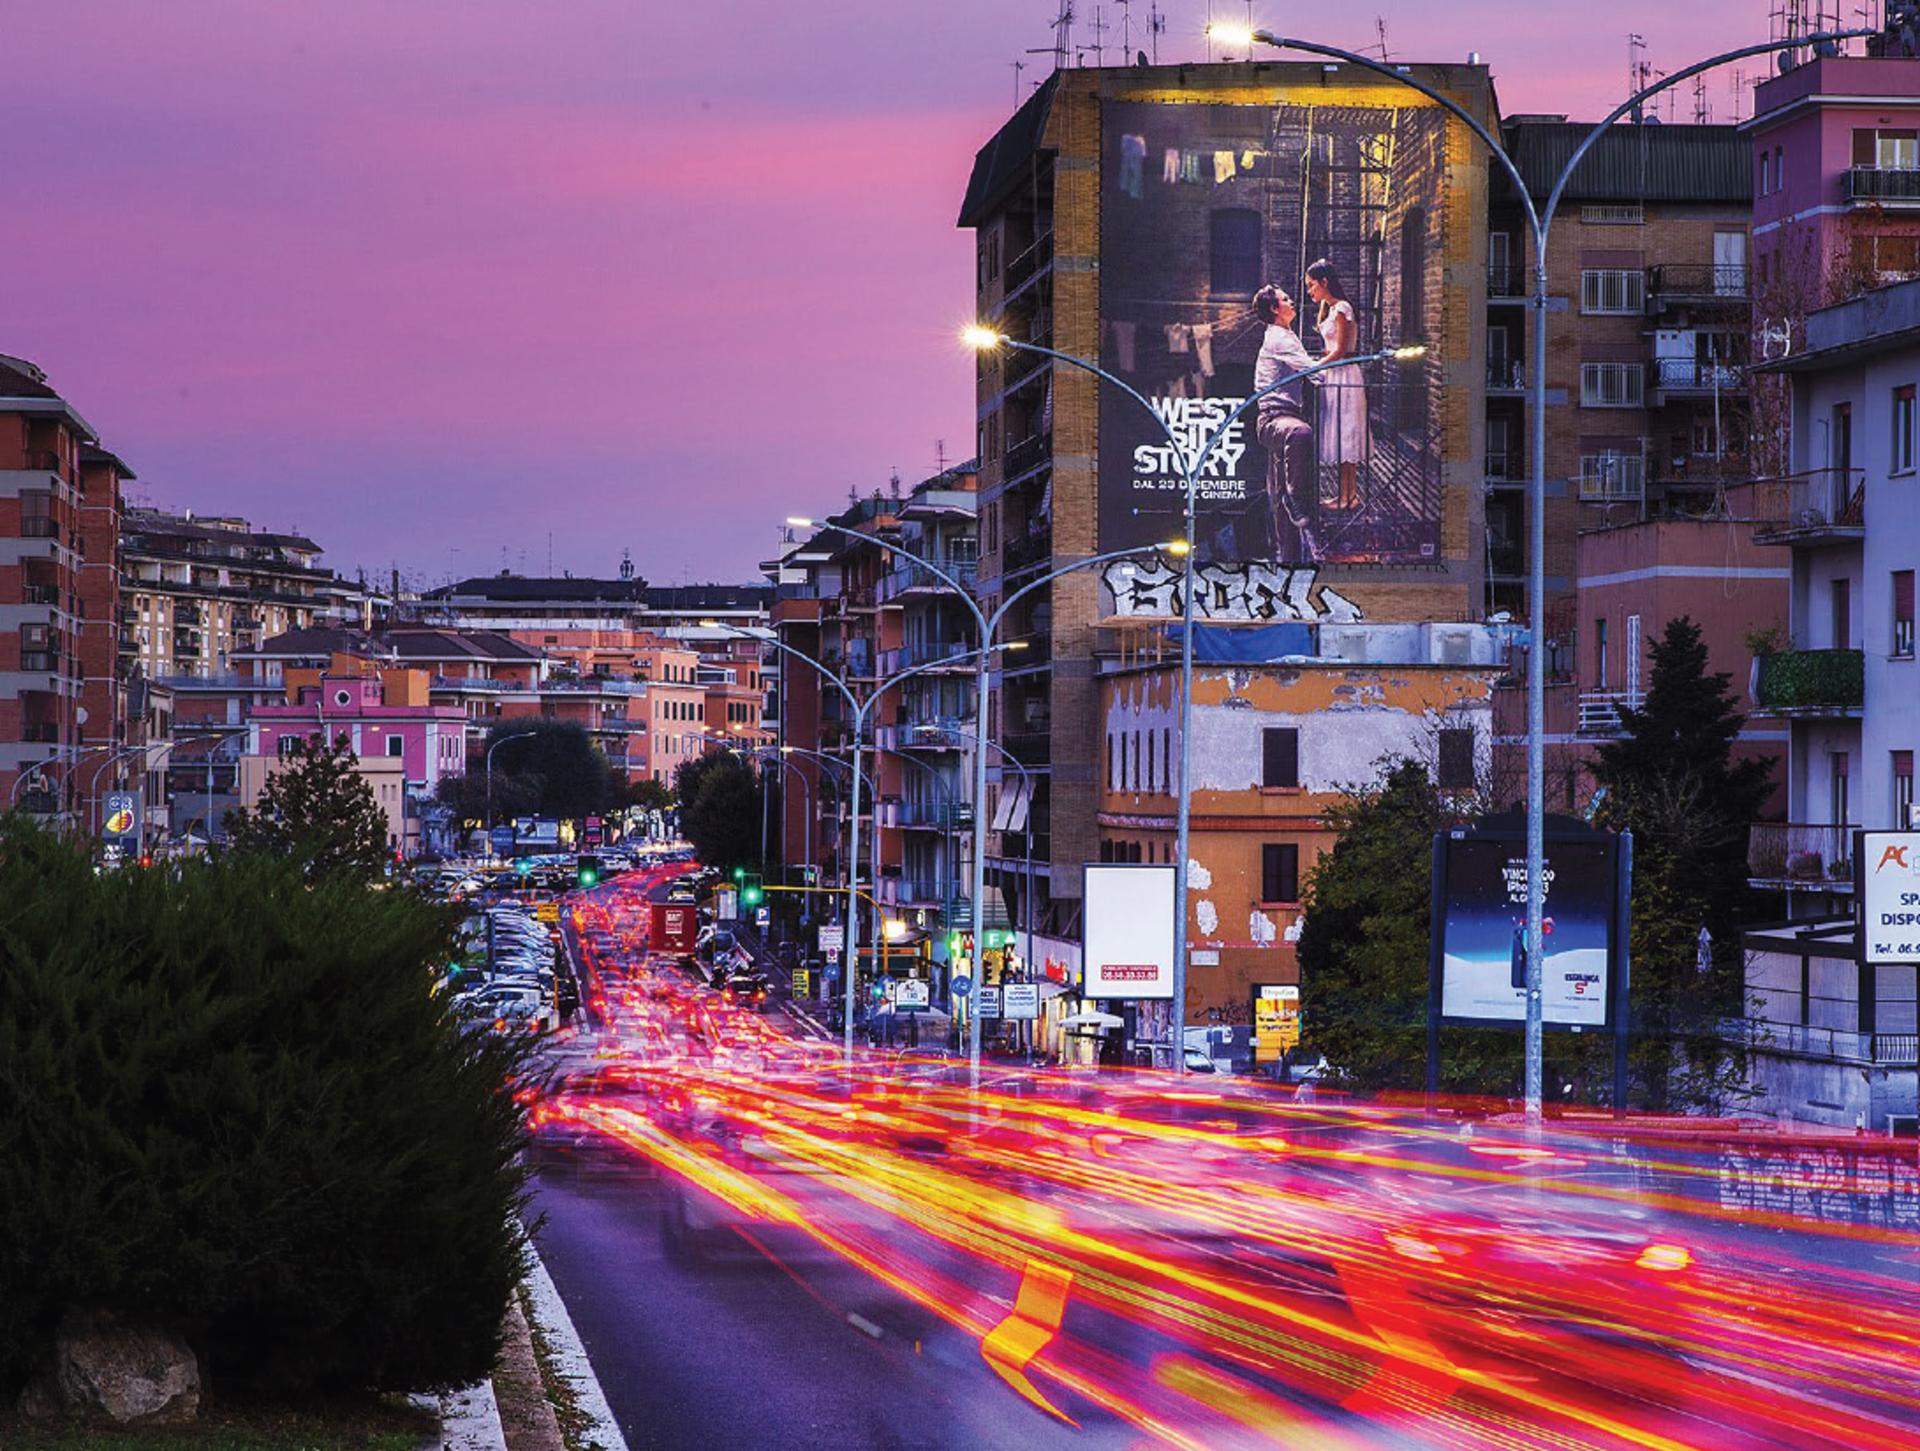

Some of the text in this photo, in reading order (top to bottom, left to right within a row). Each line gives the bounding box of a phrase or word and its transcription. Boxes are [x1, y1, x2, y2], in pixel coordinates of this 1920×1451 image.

[1150, 396, 1245, 424] WEST
[1166, 421, 1245, 450] SIDE
[1133, 443, 1246, 477] STORY
[1133, 481, 1155, 489] DAL
[1179, 481, 1246, 490] DCEMBRE
[1201, 491, 1246, 500] CINEMA
[1900, 893, 1920, 905] SP
